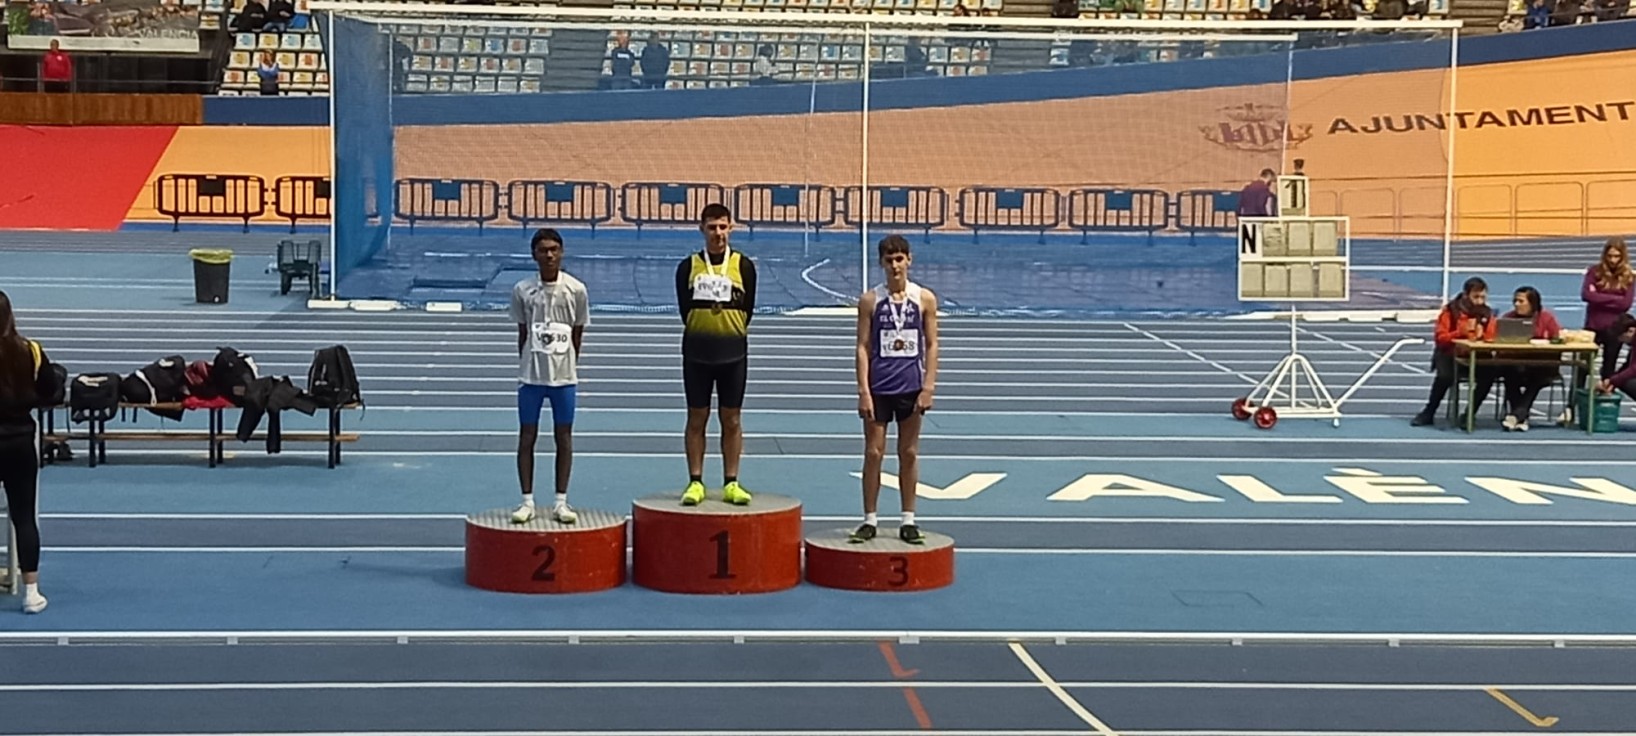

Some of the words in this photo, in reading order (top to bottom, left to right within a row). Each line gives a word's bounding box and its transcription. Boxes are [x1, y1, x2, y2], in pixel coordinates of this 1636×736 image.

[1327, 101, 1635, 135] AJUNTAMENT
[1241, 223, 1257, 254] N
[531, 545, 556, 582] 2
[709, 530, 736, 579] 1
[888, 556, 909, 587] 3
